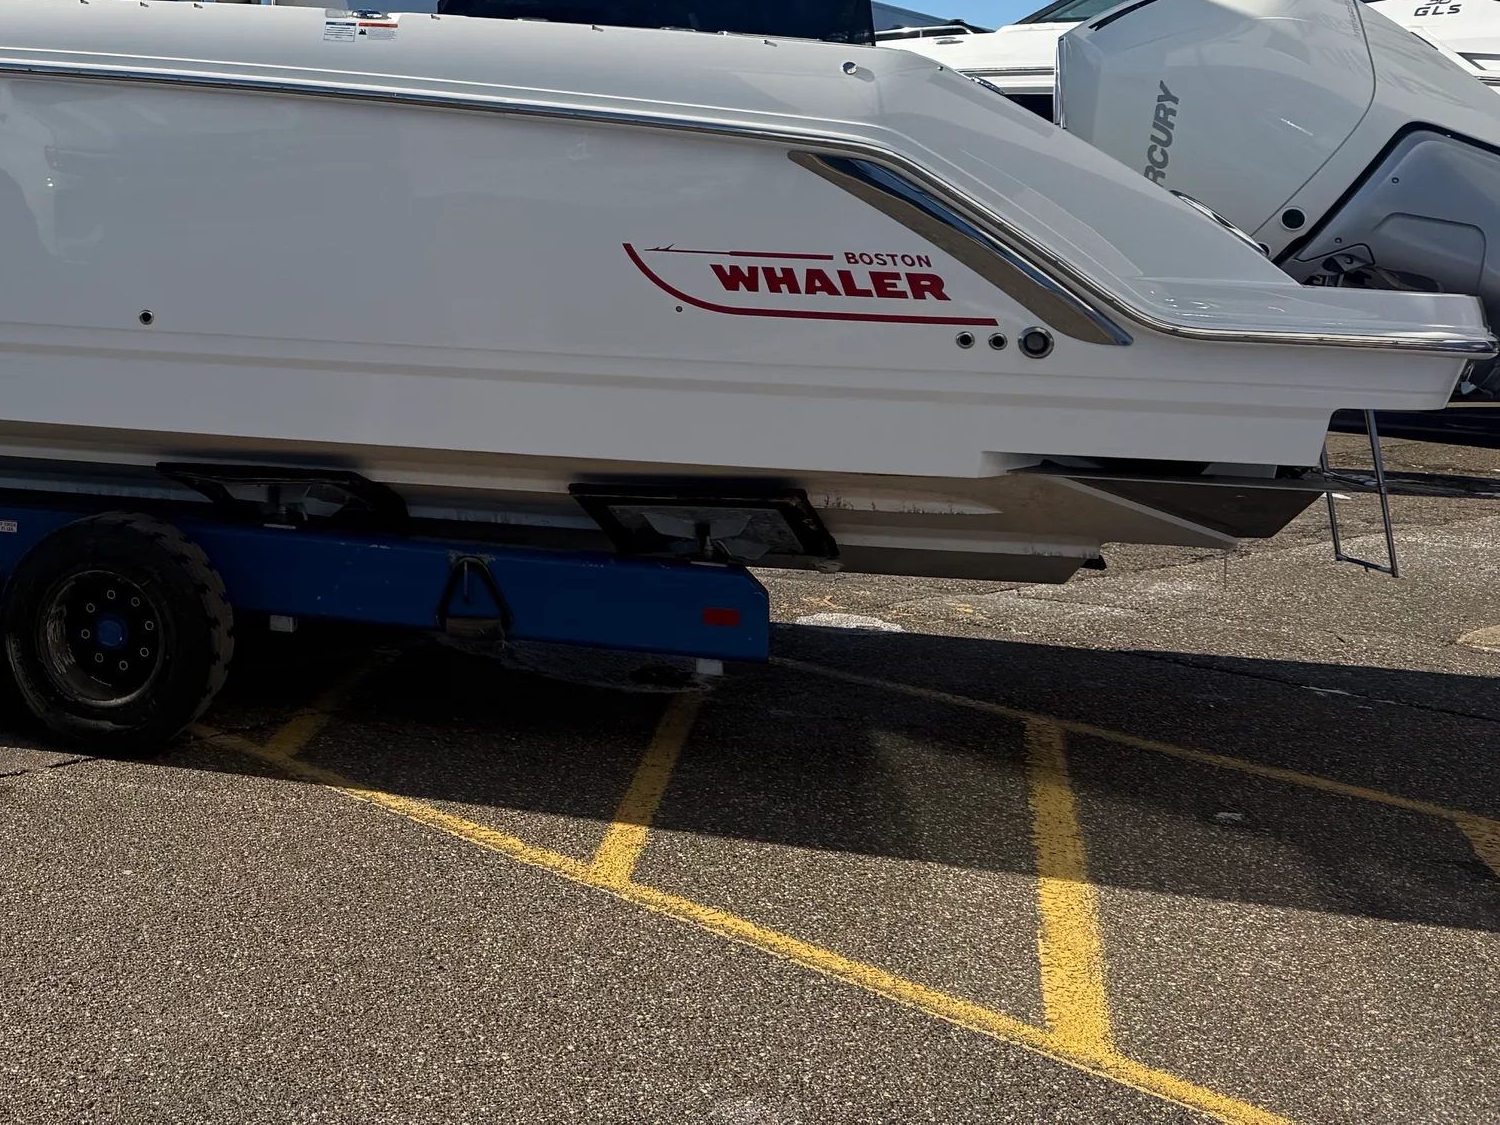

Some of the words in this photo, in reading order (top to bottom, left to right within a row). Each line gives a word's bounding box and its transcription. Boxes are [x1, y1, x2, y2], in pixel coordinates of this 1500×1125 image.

[1413, 4, 1462, 17] GLS
[1143, 80, 1180, 188] RCURY
[843, 251, 933, 268] BOSTON
[709, 263, 952, 302] WHALER
